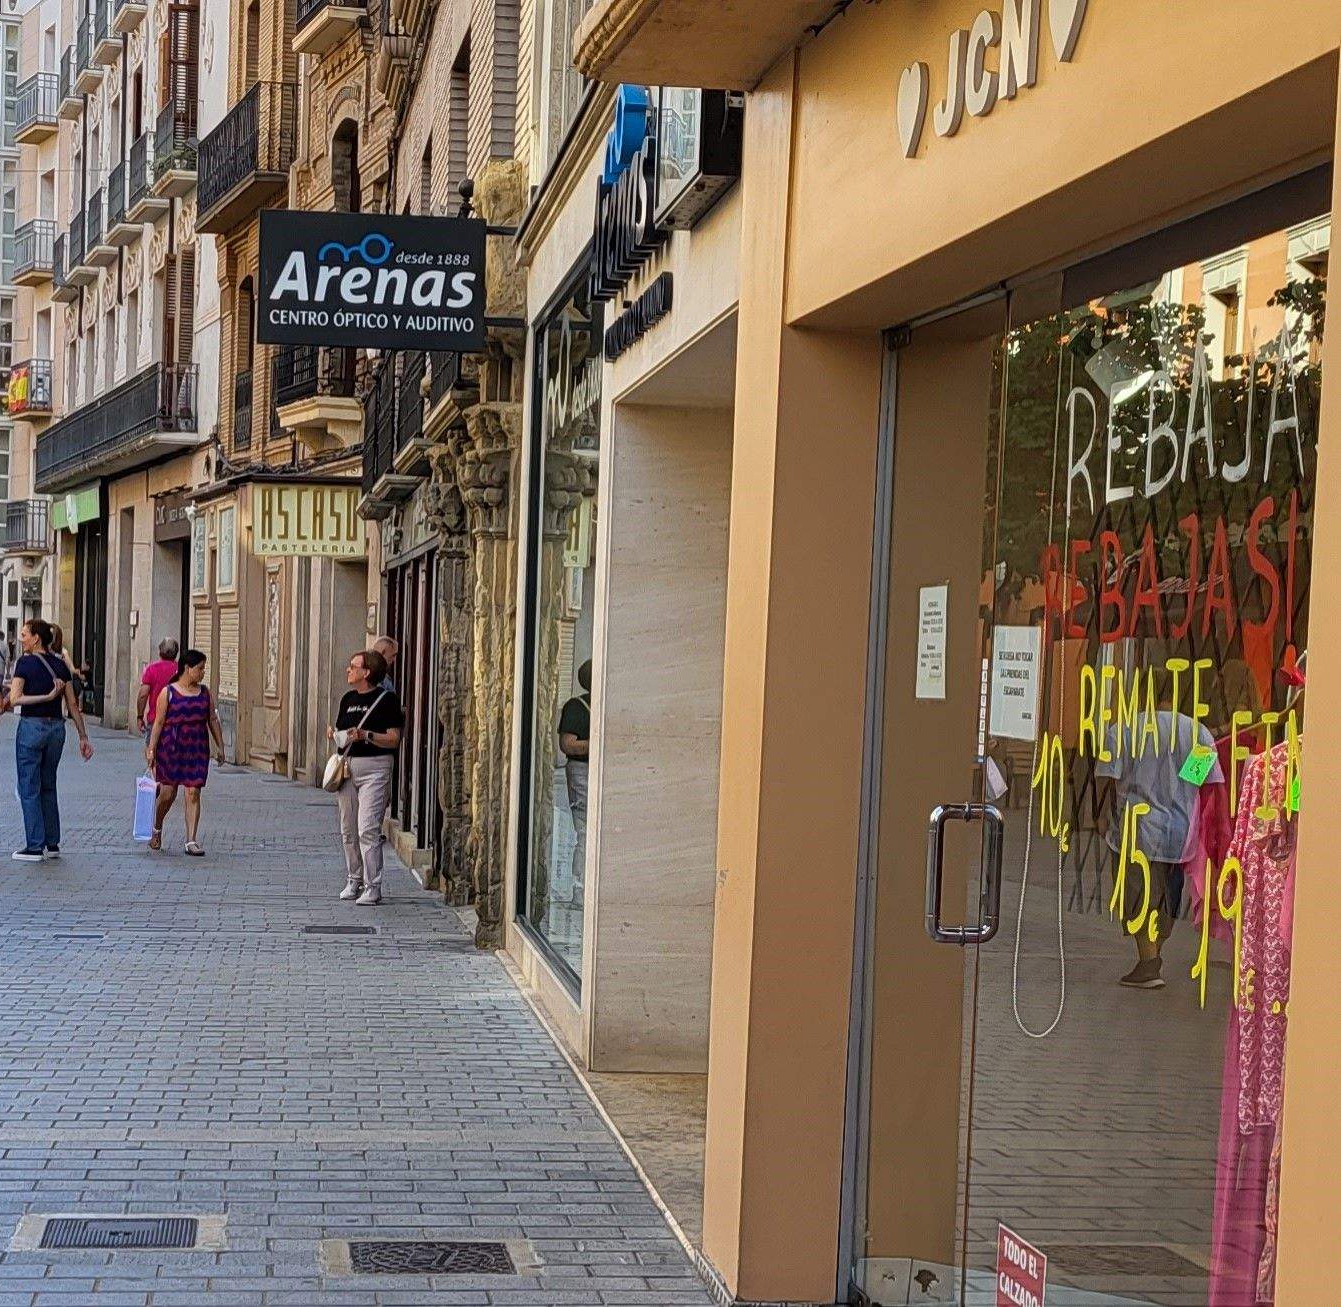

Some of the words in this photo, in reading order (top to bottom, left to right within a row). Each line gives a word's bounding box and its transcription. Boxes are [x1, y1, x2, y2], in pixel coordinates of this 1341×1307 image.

[933, 0, 1040, 137] JCN
[270, 251, 476, 308] Arenas
[396, 251, 433, 265] desde
[437, 254, 470, 266] 1888
[269, 309, 329, 326] CENTRO
[333, 309, 388, 329] ÓPTICO
[392, 315, 402, 330] Y
[406, 315, 475, 333] AUDITIVO
[261, 487, 359, 541] ASCASO
[1079, 658, 1213, 762] REMATE
[1003, 1235, 1027, 1270] TODO
[1028, 1254, 1038, 1280] EL
